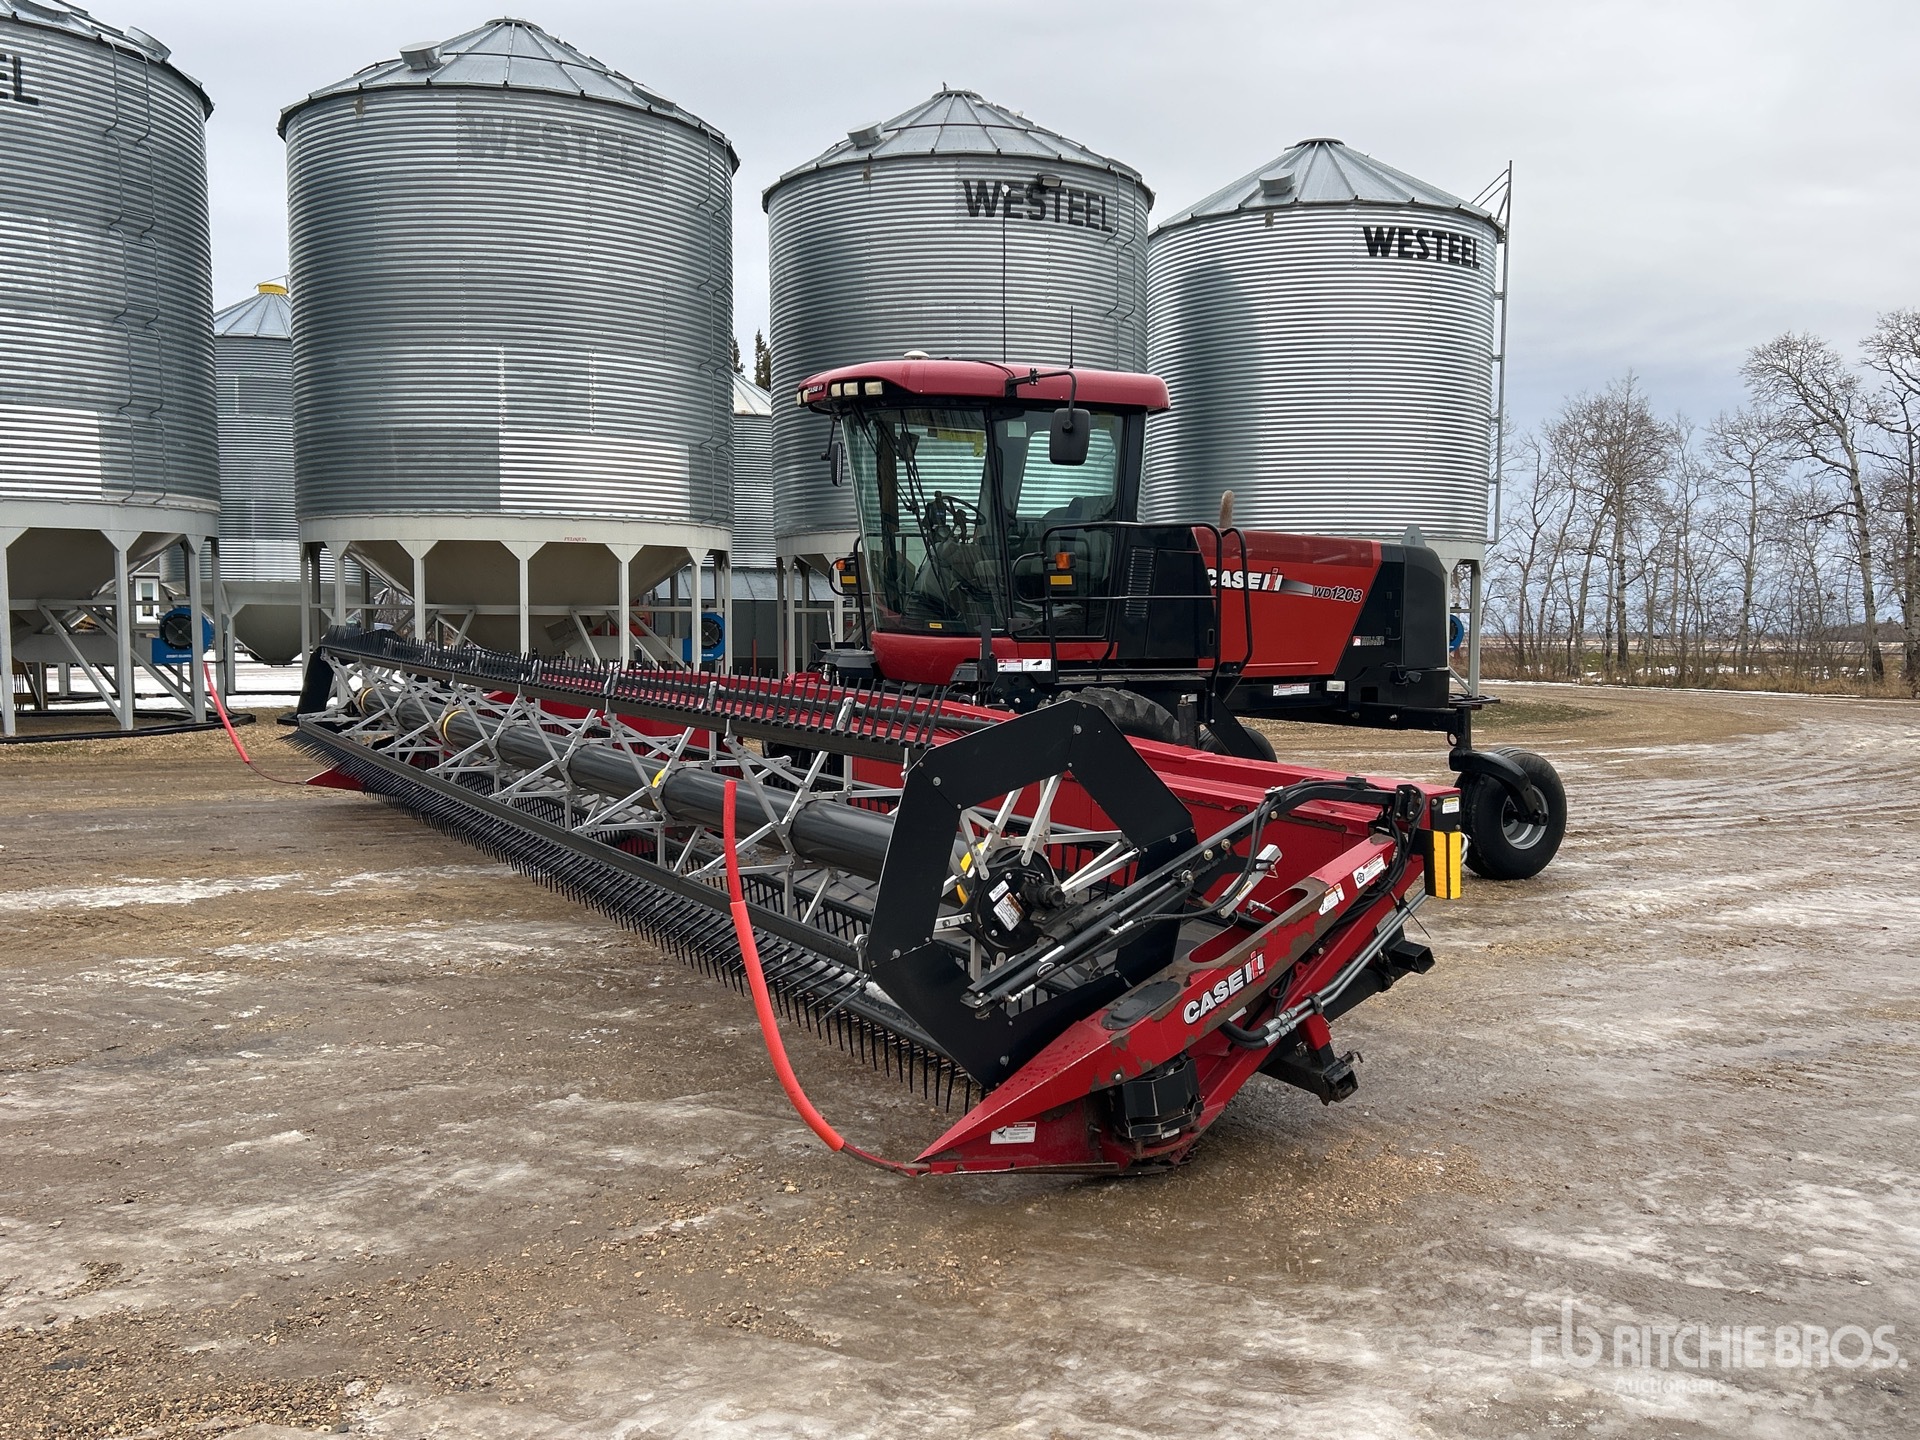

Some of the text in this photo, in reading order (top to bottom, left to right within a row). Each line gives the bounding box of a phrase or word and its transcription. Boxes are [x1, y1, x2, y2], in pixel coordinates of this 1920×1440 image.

[962, 179, 1112, 233] WESTEEL
[1362, 226, 1481, 270] WESTEEL
[1207, 568, 1262, 591] CASE
[1313, 585, 1364, 604] WD1203
[1183, 968, 1245, 1025] CASE
